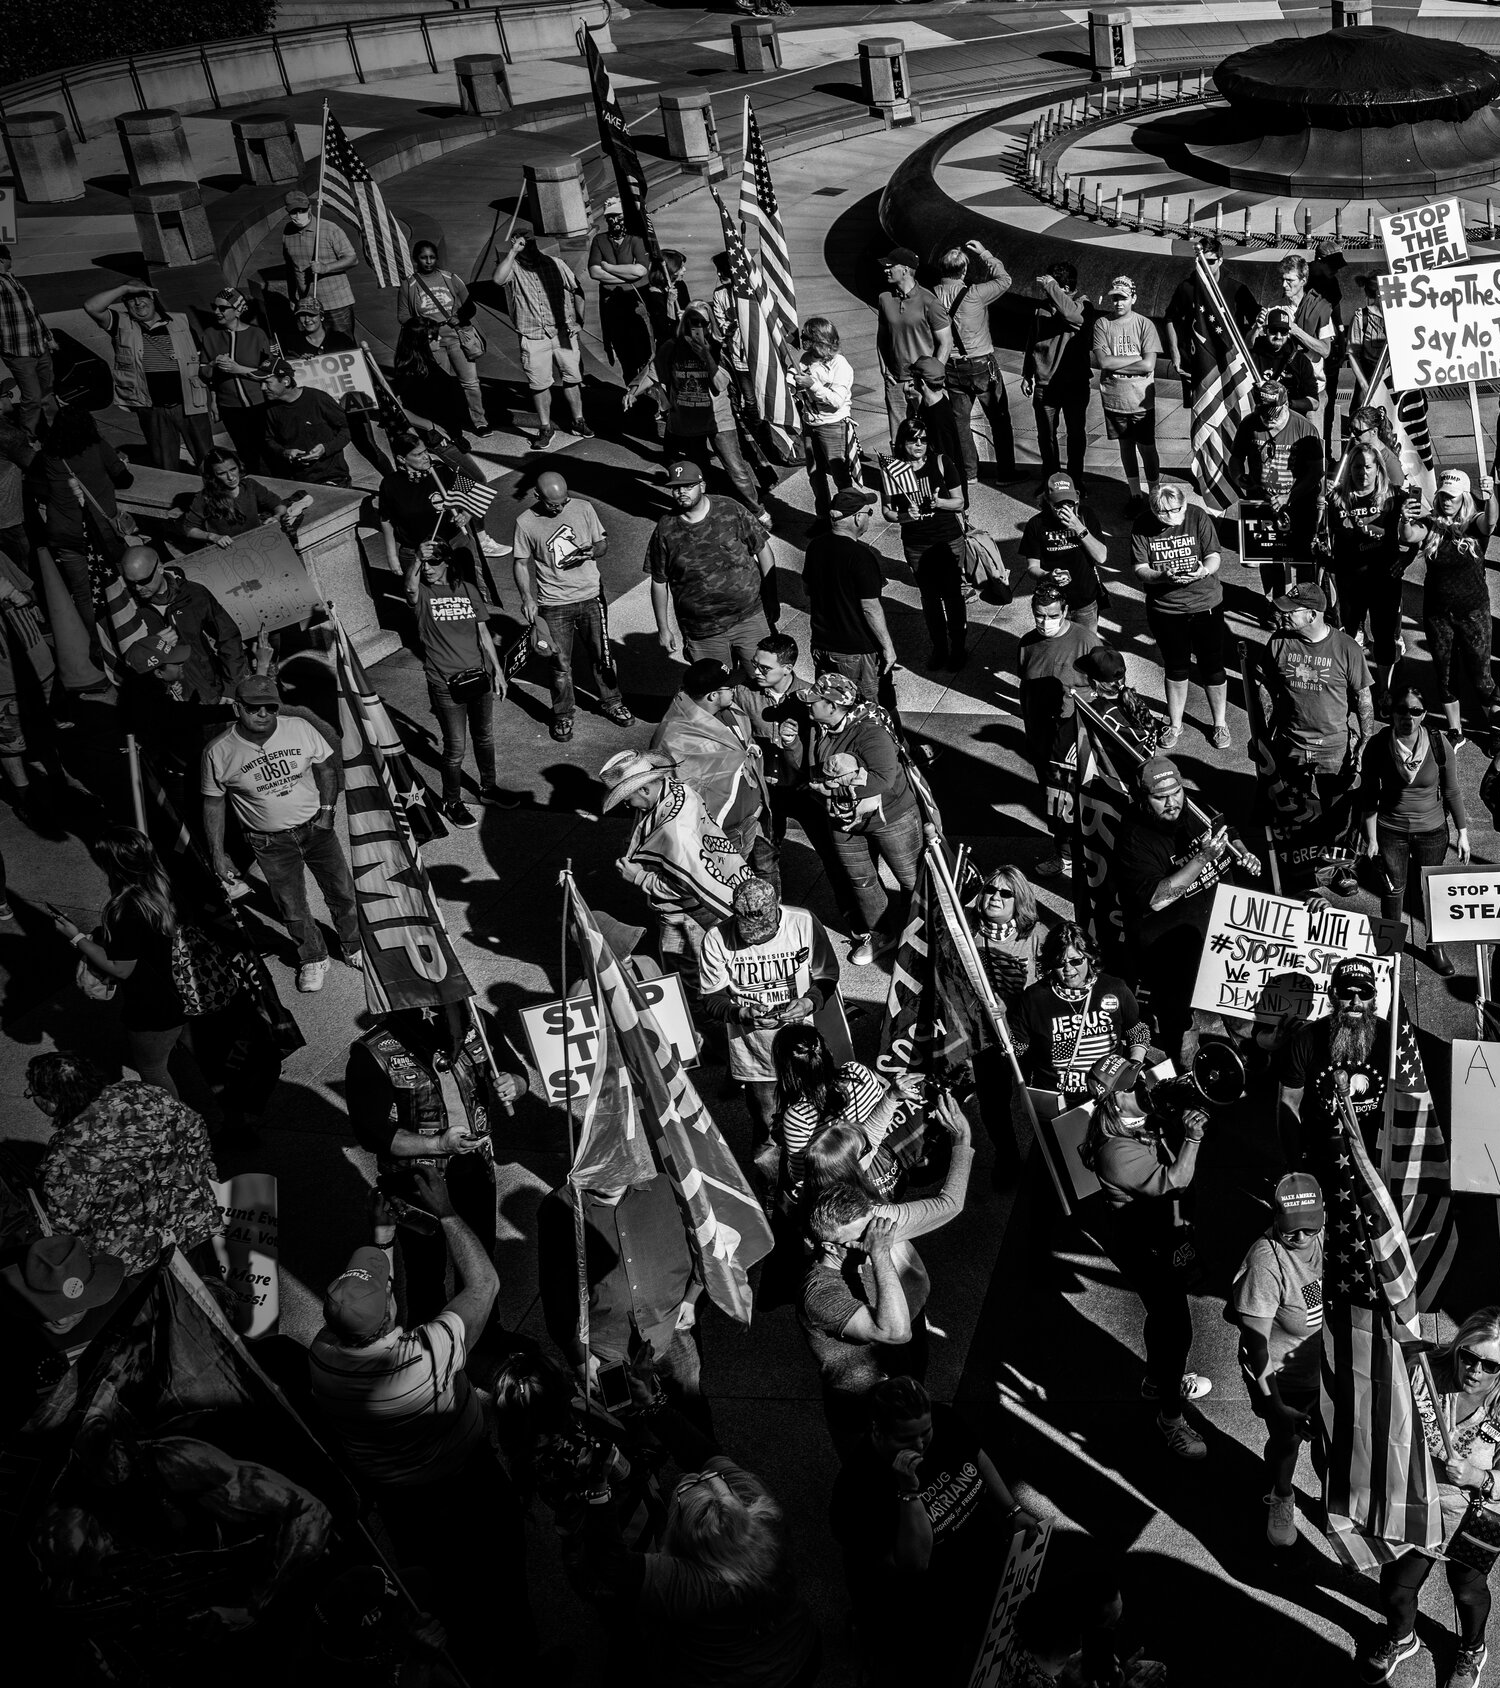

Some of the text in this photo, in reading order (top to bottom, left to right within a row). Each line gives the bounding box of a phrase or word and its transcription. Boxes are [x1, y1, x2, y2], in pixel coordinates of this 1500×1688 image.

[1390, 204, 1450, 236] STOP
[1401, 226, 1450, 253] THE
[1392, 242, 1467, 274] STEAL
[1412, 326, 1456, 359] Say
[1462, 321, 1491, 348] No
[292, 354, 355, 380] STOP
[1149, 536, 1196, 552] HELL YEAH!
[1155, 548, 1192, 561] I VOTED
[430, 597, 471, 605] DEFUND
[432, 608, 476, 618] MEDIA
[147, 656, 160, 667] 45
[1303, 654, 1312, 664] OF
[1314, 656, 1332, 668] IRON
[1290, 680, 1323, 692] MINISTRIES
[268, 748, 302, 762] SERVICE
[260, 760, 292, 782] USO
[256, 772, 304, 794] ORGANIZATIONS
[1447, 884, 1489, 896] STOP
[744, 909, 764, 919] NRA
[1230, 895, 1395, 956] UNITE WITH 45
[734, 956, 801, 986] TRUMP
[1225, 960, 1330, 993] We The Peopl
[1340, 962, 1372, 975] TRUMP
[1219, 982, 1292, 1012] DEMAND
[1052, 1010, 1112, 1034] JESUS
[1052, 1030, 1078, 1042] IS MY
[1465, 1045, 1496, 1088] A
[1355, 1102, 1378, 1114] BOYS
[1284, 1200, 1300, 1208] GREAT
[921, 1472, 950, 1502] DOUG
[934, 1513, 956, 1534] FIGHTING
[960, 1478, 984, 1506] FREEDOM
